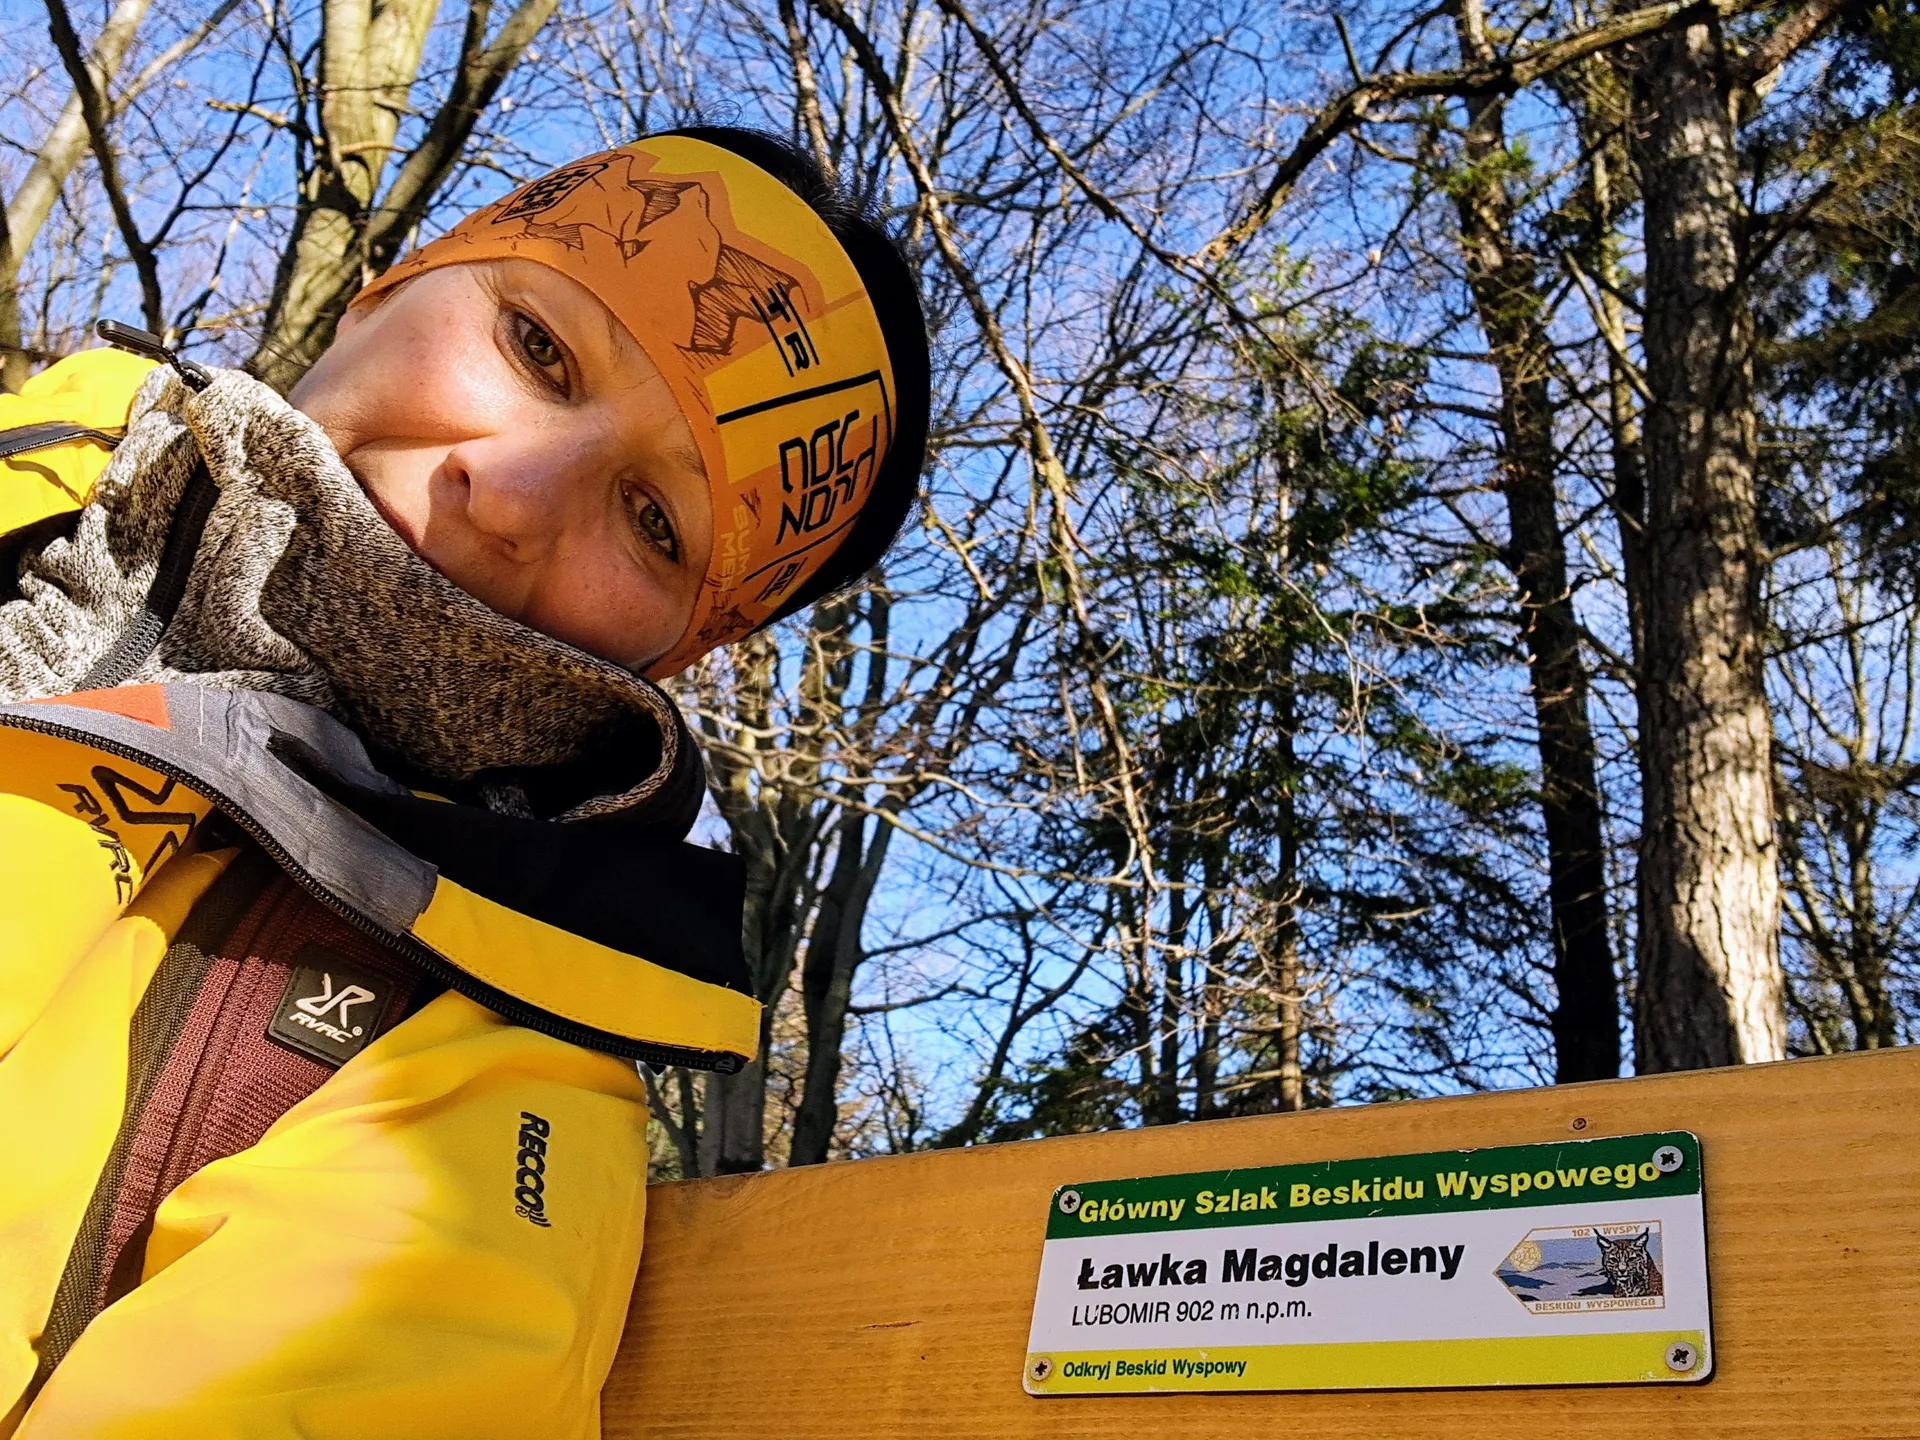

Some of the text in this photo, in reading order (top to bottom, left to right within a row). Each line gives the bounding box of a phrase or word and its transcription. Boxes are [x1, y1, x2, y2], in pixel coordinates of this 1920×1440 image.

[56, 783, 133, 905] RVRC
[289, 1012, 353, 1043] RVRC
[515, 1111, 550, 1212] RECCO
[1079, 1163, 1660, 1223] Główny Szlak Beskidu Wyspowego
[1572, 1225, 1641, 1238] 102 WYSPY
[1077, 1240, 1465, 1291] Ławka Magdaleny
[1071, 1299, 1312, 1326] LUBOMIR 902 m n.p.m.
[1535, 1297, 1656, 1312] BESKIDU WYSPOWEGO
[1063, 1358, 1248, 1380] Odkryj Beskid Wyspowy
